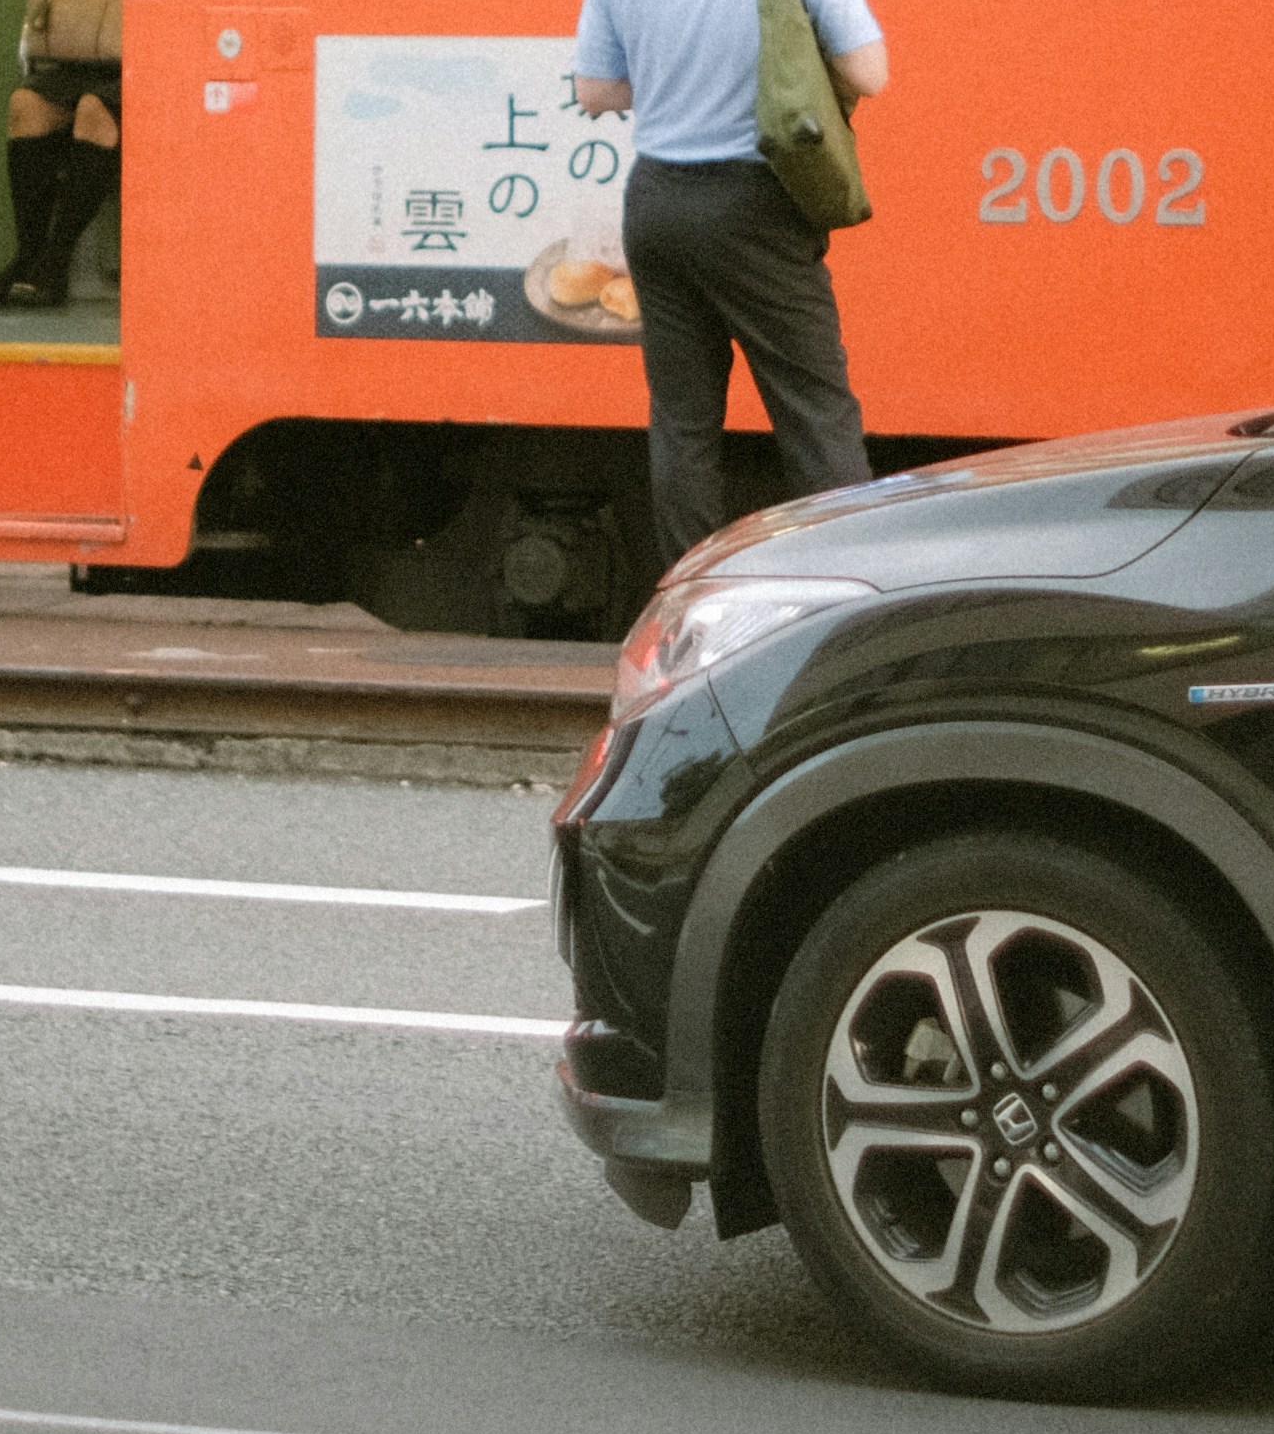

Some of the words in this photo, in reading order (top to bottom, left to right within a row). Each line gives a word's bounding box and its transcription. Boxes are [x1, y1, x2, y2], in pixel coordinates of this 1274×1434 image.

[482, 92, 549, 218] 上の
[978, 146, 1206, 227] 2002
[401, 188, 468, 252] 雲
